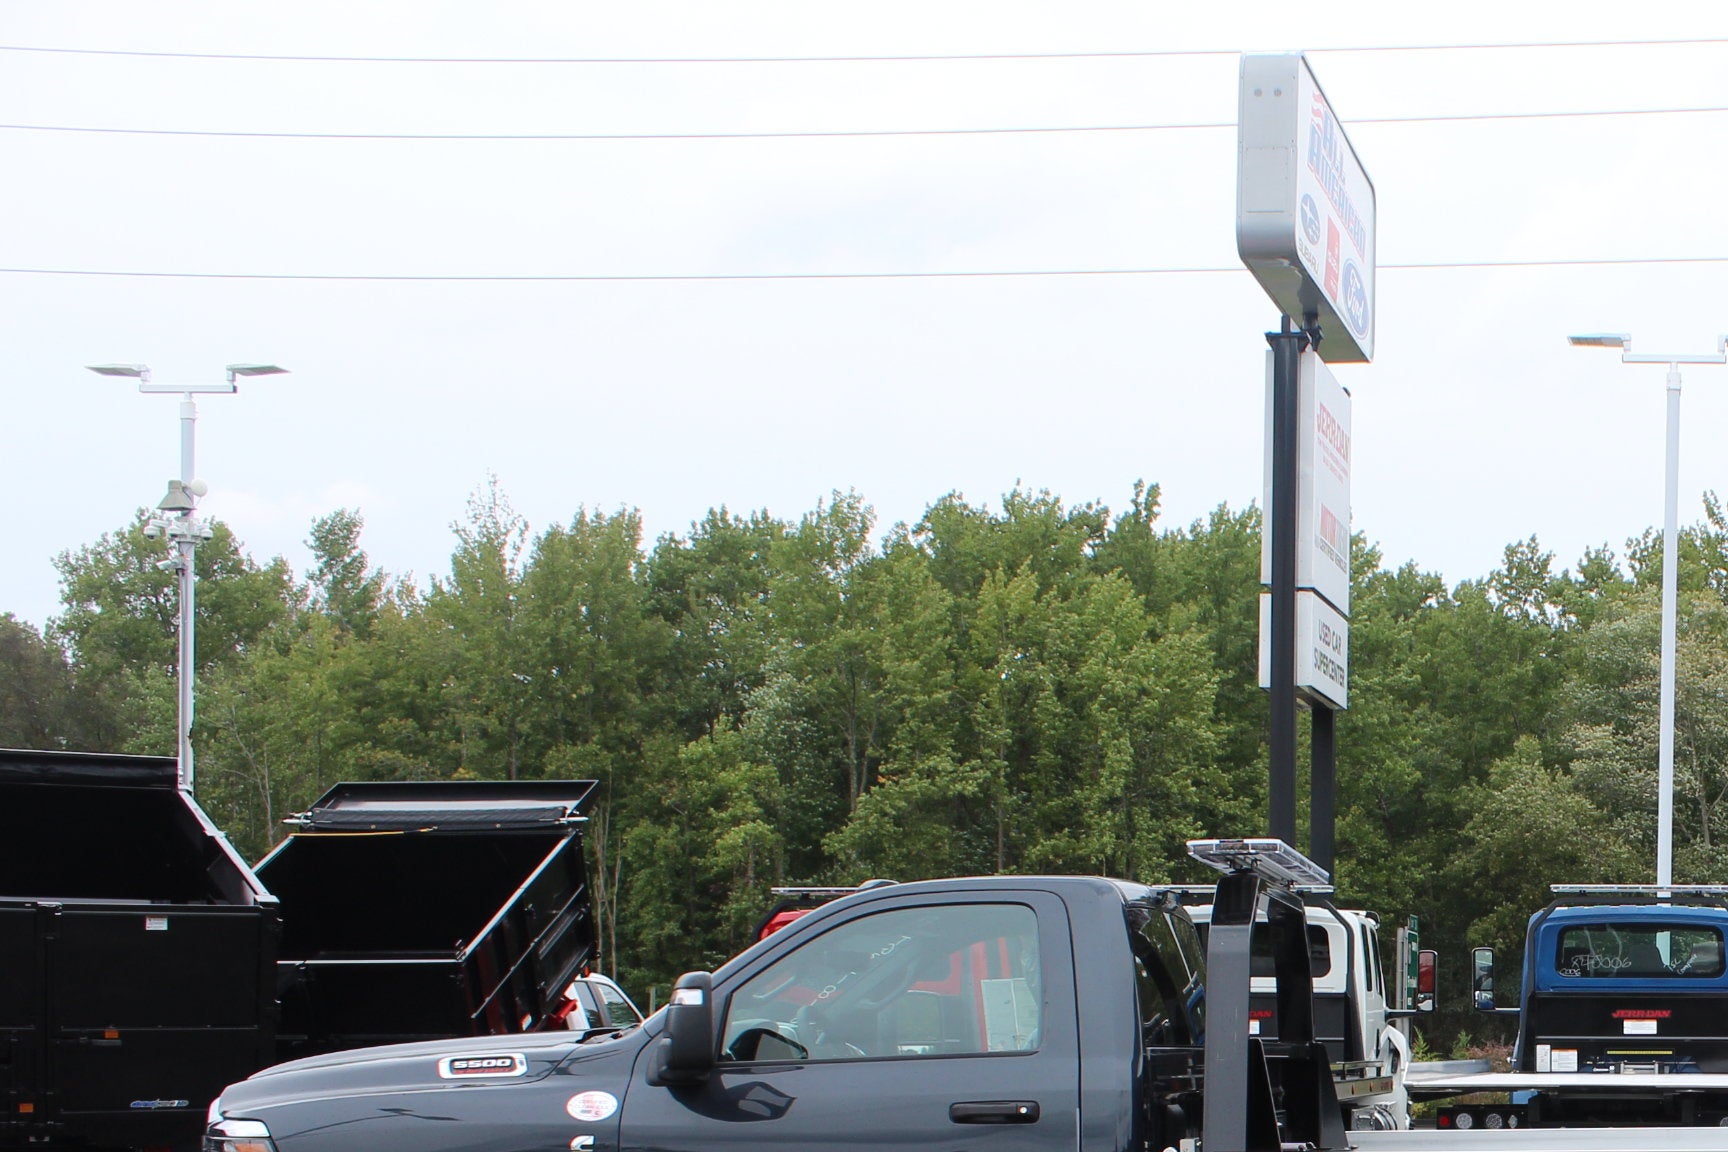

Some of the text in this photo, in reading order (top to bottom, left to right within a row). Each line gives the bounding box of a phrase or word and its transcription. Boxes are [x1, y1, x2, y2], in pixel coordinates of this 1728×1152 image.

[1318, 619, 1342, 656] USED CAR
[1313, 647, 1345, 687] SUPERCENTER
[453, 1058, 512, 1069] 5500
